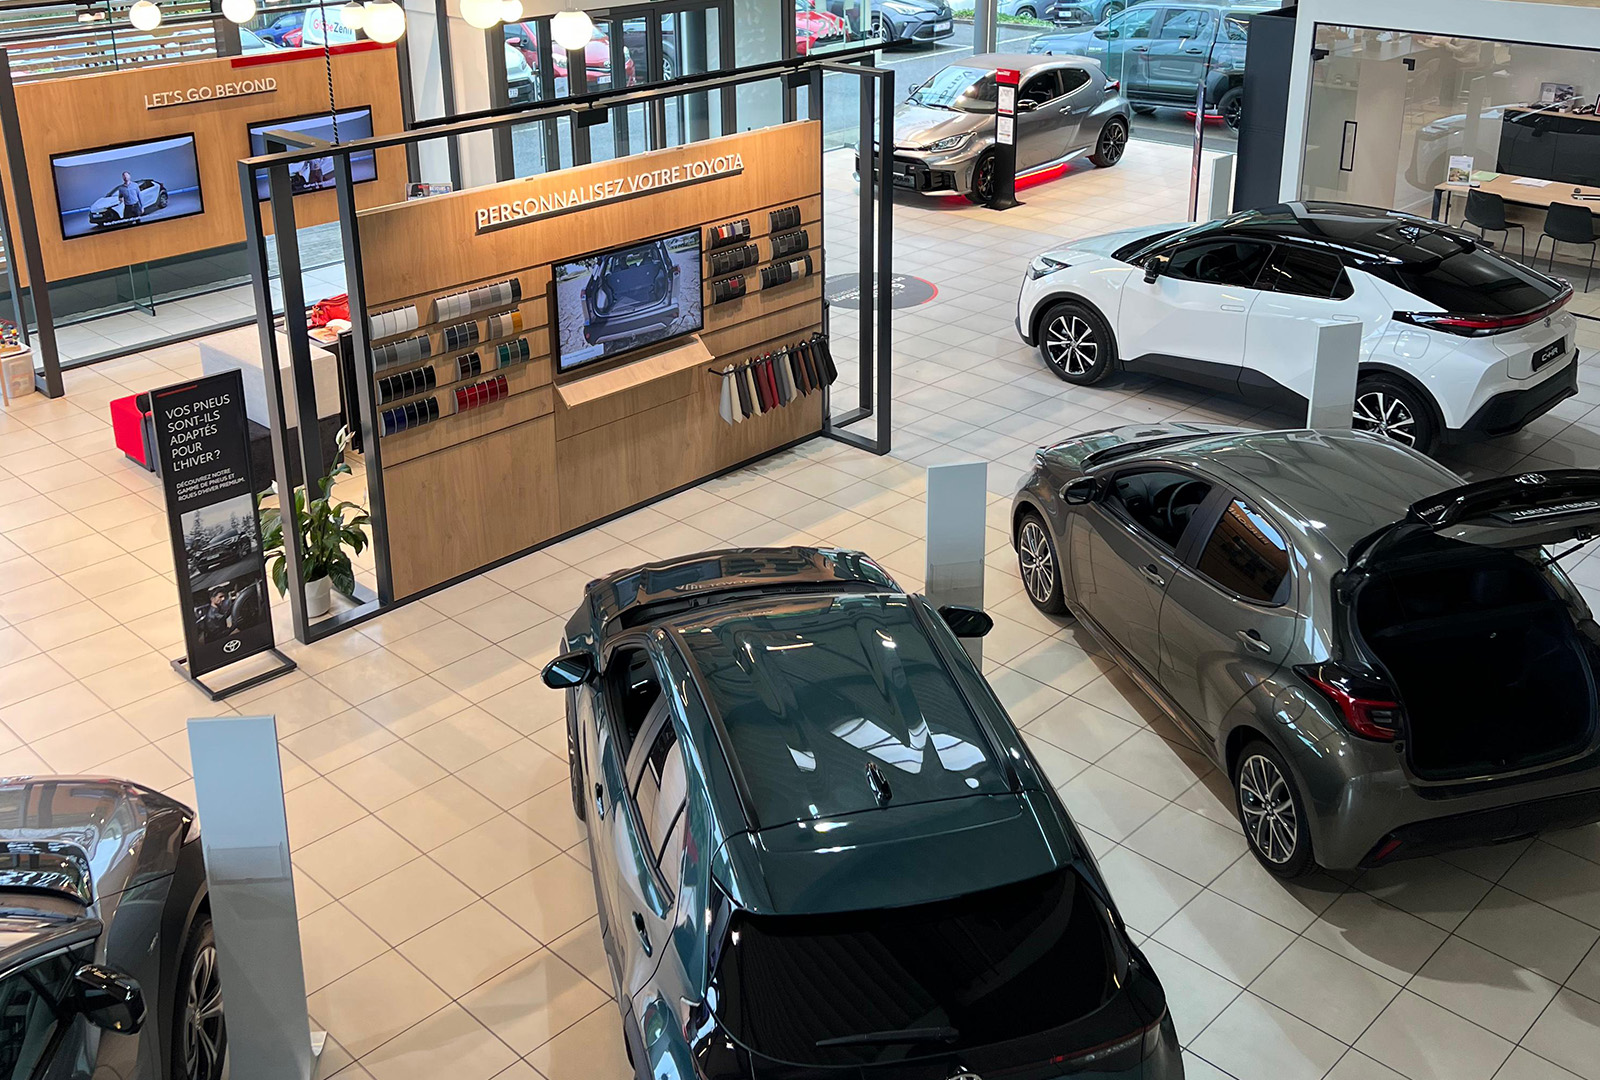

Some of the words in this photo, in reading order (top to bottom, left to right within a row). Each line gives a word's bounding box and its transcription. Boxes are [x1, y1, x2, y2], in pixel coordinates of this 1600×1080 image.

[144, 90, 183, 107] LET'S
[187, 86, 212, 101] GO
[215, 77, 277, 97] BEYOND
[477, 178, 625, 227] PERSONNALISEZ
[628, 167, 680, 192] VOTRE
[683, 153, 744, 178] TOYOTA
[165, 404, 191, 420] VOS
[193, 393, 231, 413] PNEUS
[167, 409, 221, 433] SONT-ILS
[169, 423, 218, 446] ADAPTÉS
[171, 441, 203, 459] POUR
[176, 474, 211, 489] DÉCOUVREZ
[211, 467, 231, 479] NOTRE
[177, 484, 200, 495] GAMME
[200, 481, 208, 489] DE
[208, 476, 228, 485] PNEUS
[178, 491, 198, 501] ROUES
